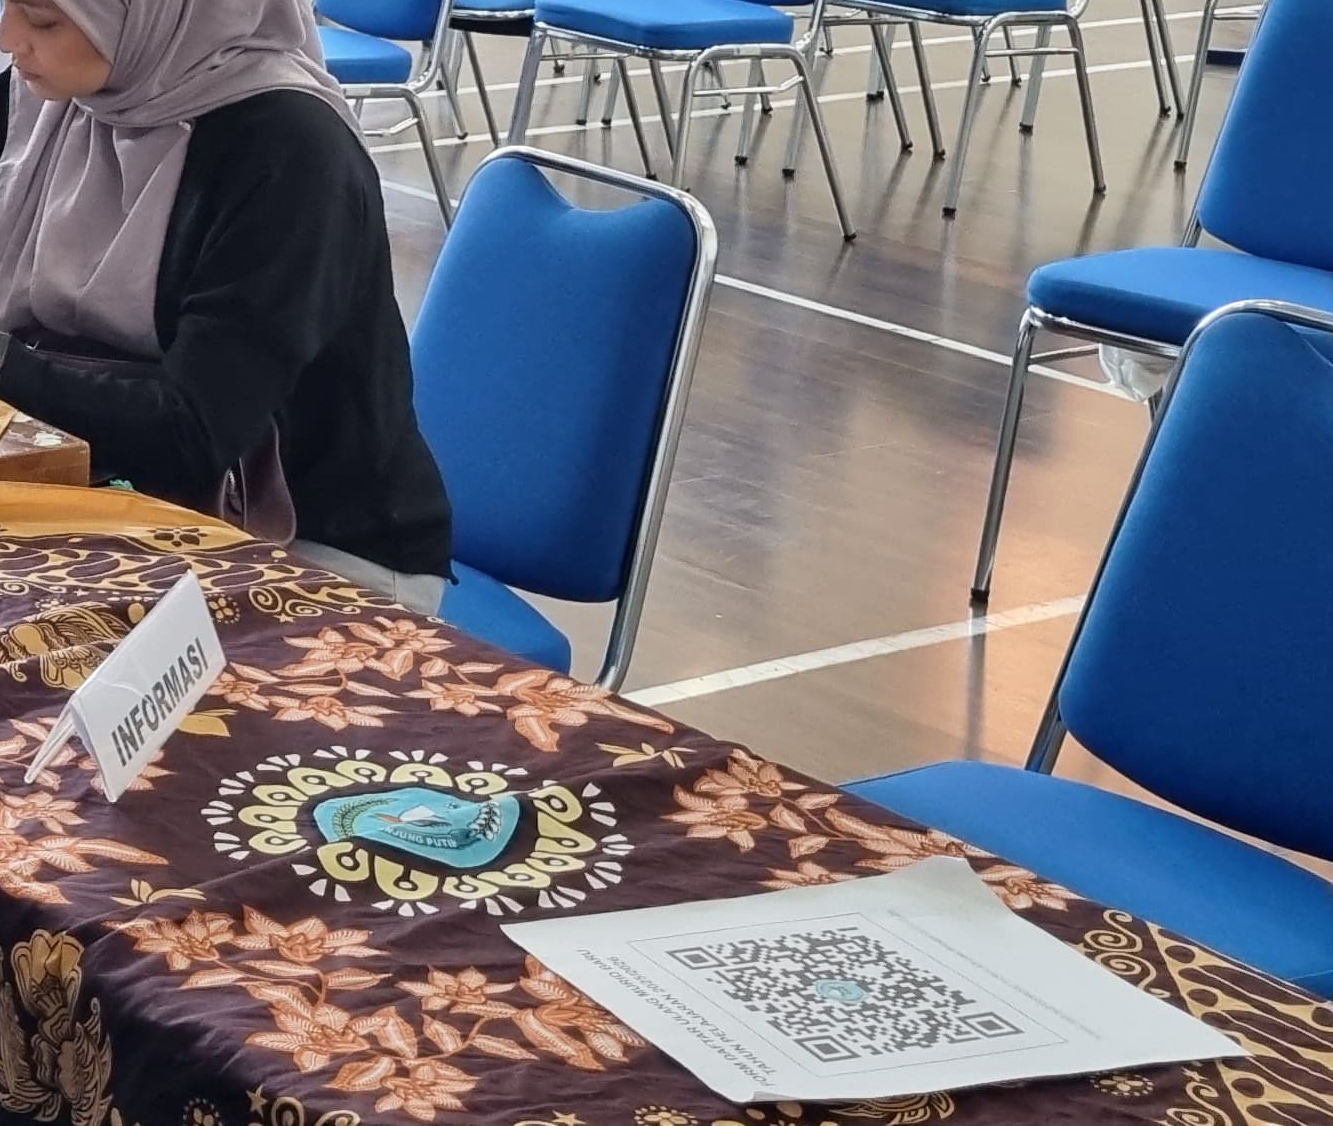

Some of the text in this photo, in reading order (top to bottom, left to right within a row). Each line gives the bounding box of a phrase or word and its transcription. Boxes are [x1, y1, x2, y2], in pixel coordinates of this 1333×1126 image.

[110, 638, 209, 767] INFORMASI
[576, 948, 775, 1087] FORM DAFTAR ULANG MURID BARU
[663, 993, 734, 1043] PELAJARAN
[731, 1043, 776, 1074] TAHUN
